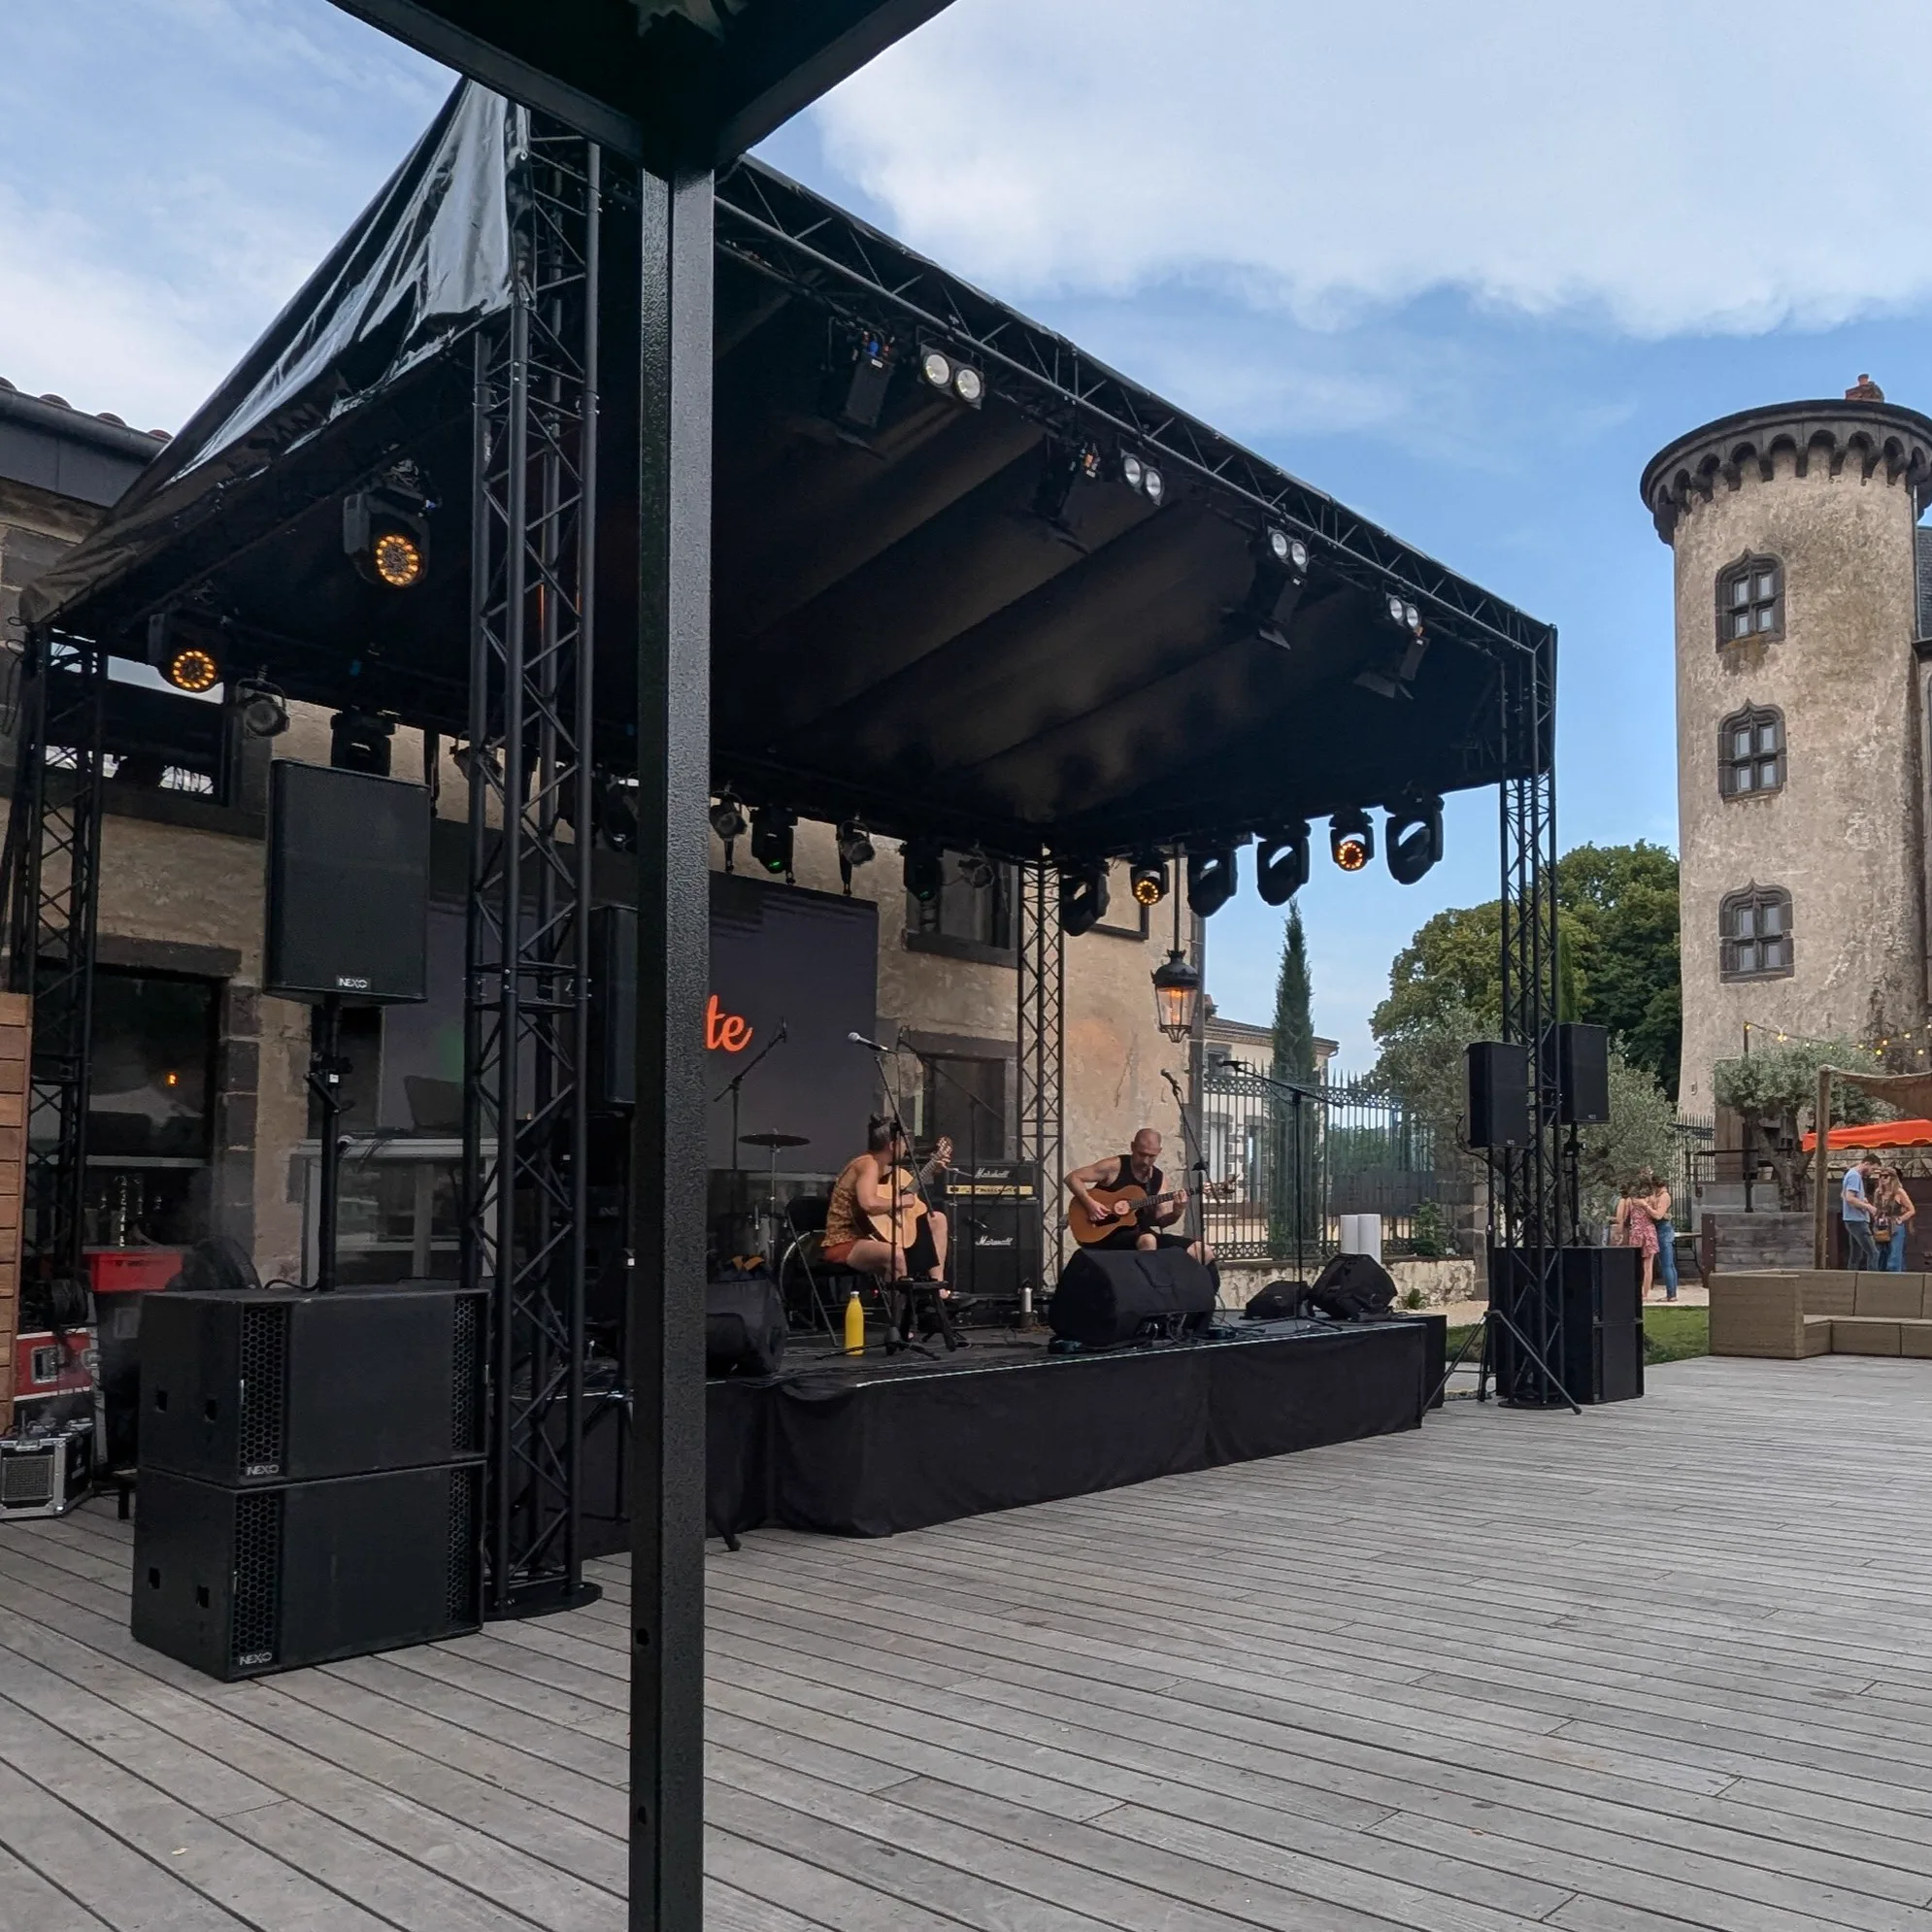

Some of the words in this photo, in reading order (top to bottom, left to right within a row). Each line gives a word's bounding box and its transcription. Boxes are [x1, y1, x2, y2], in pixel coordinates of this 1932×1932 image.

[338, 977, 368, 989] NEXO
[246, 1464, 281, 1476] NEXO
[239, 1651, 273, 1666] NEXO
